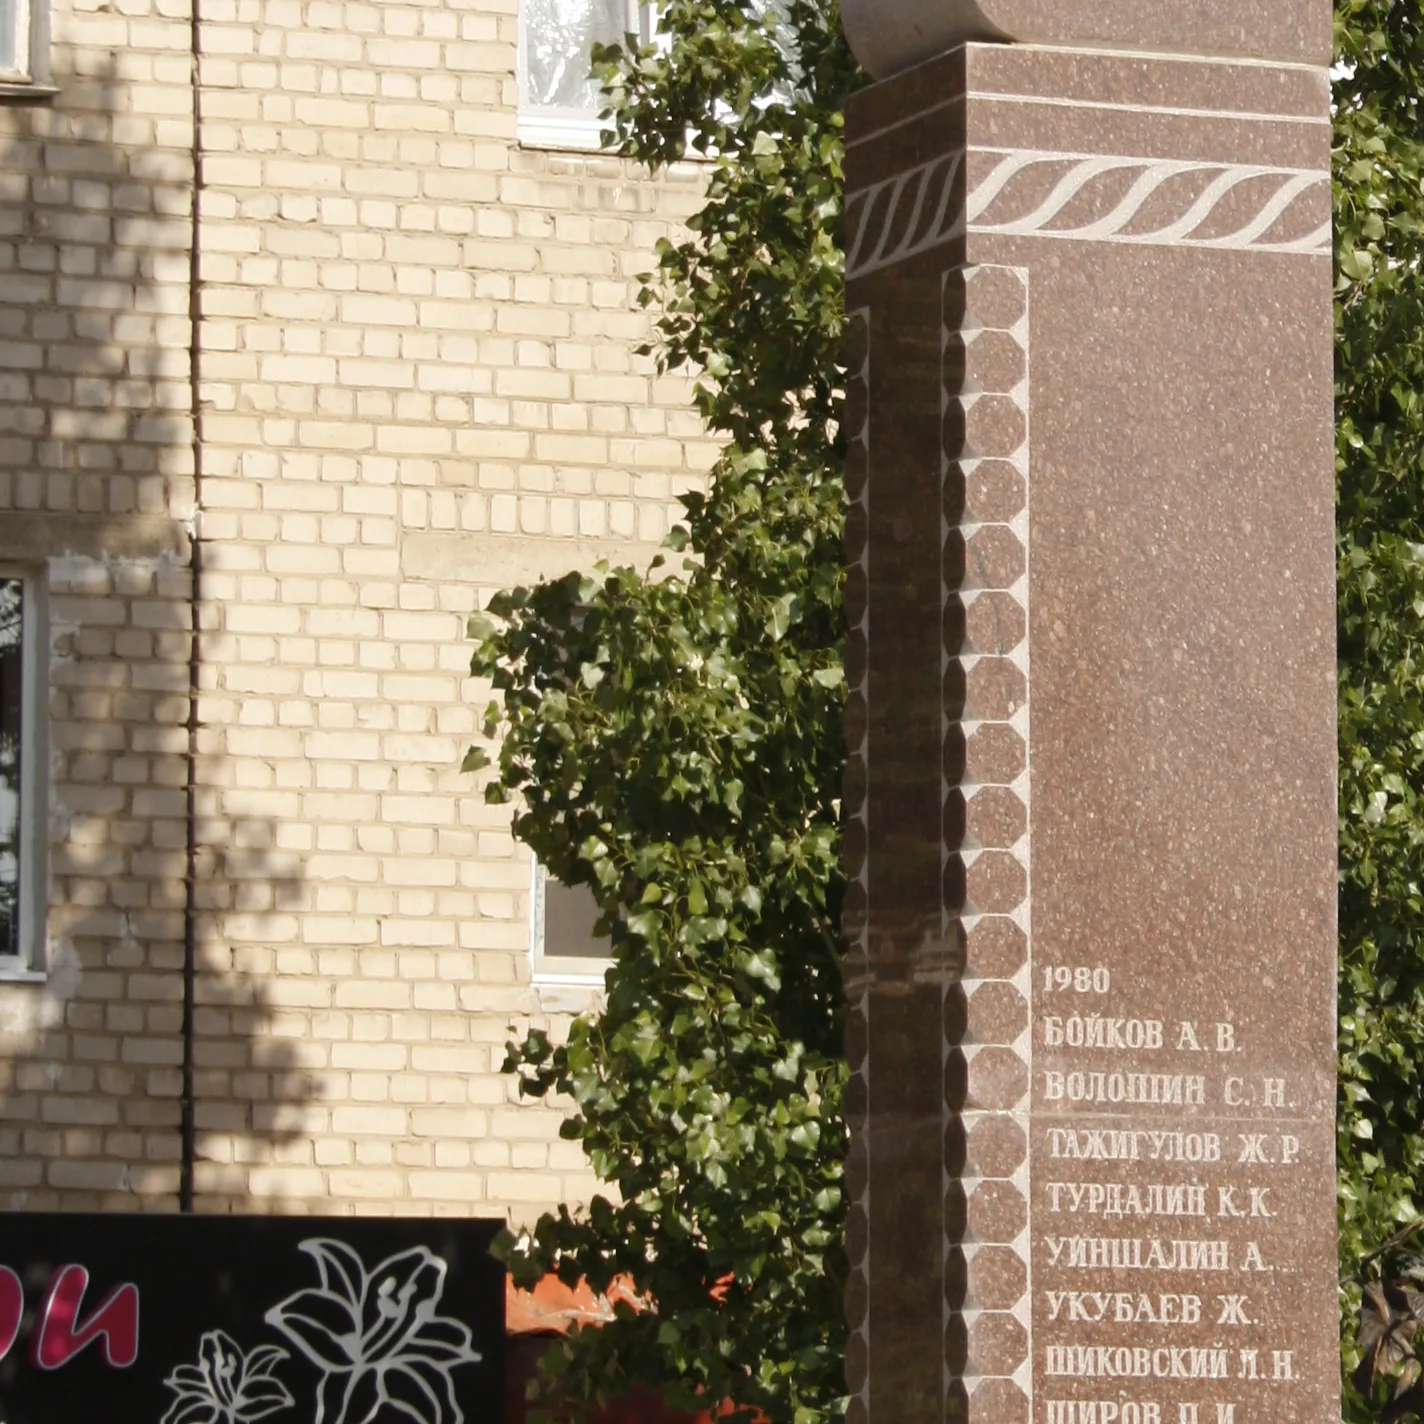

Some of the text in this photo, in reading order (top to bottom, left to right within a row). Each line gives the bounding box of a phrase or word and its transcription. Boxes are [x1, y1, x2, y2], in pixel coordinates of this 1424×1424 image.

[1043, 965, 1111, 994] 1980
[1043, 1012, 1242, 1052] БОЙКОВ А. В.
[1043, 1072, 1294, 1108] ВОЛОШИН С. Н.
[1047, 1128, 1221, 1162] ТАЖИГУЛОВ
[1046, 1182, 1206, 1219] ТУРДАЛИН
[1045, 1291, 1259, 1325] УКУБАЕВ Ж.
[1044, 1342, 1229, 1378] ШИКОВСКИЙ
